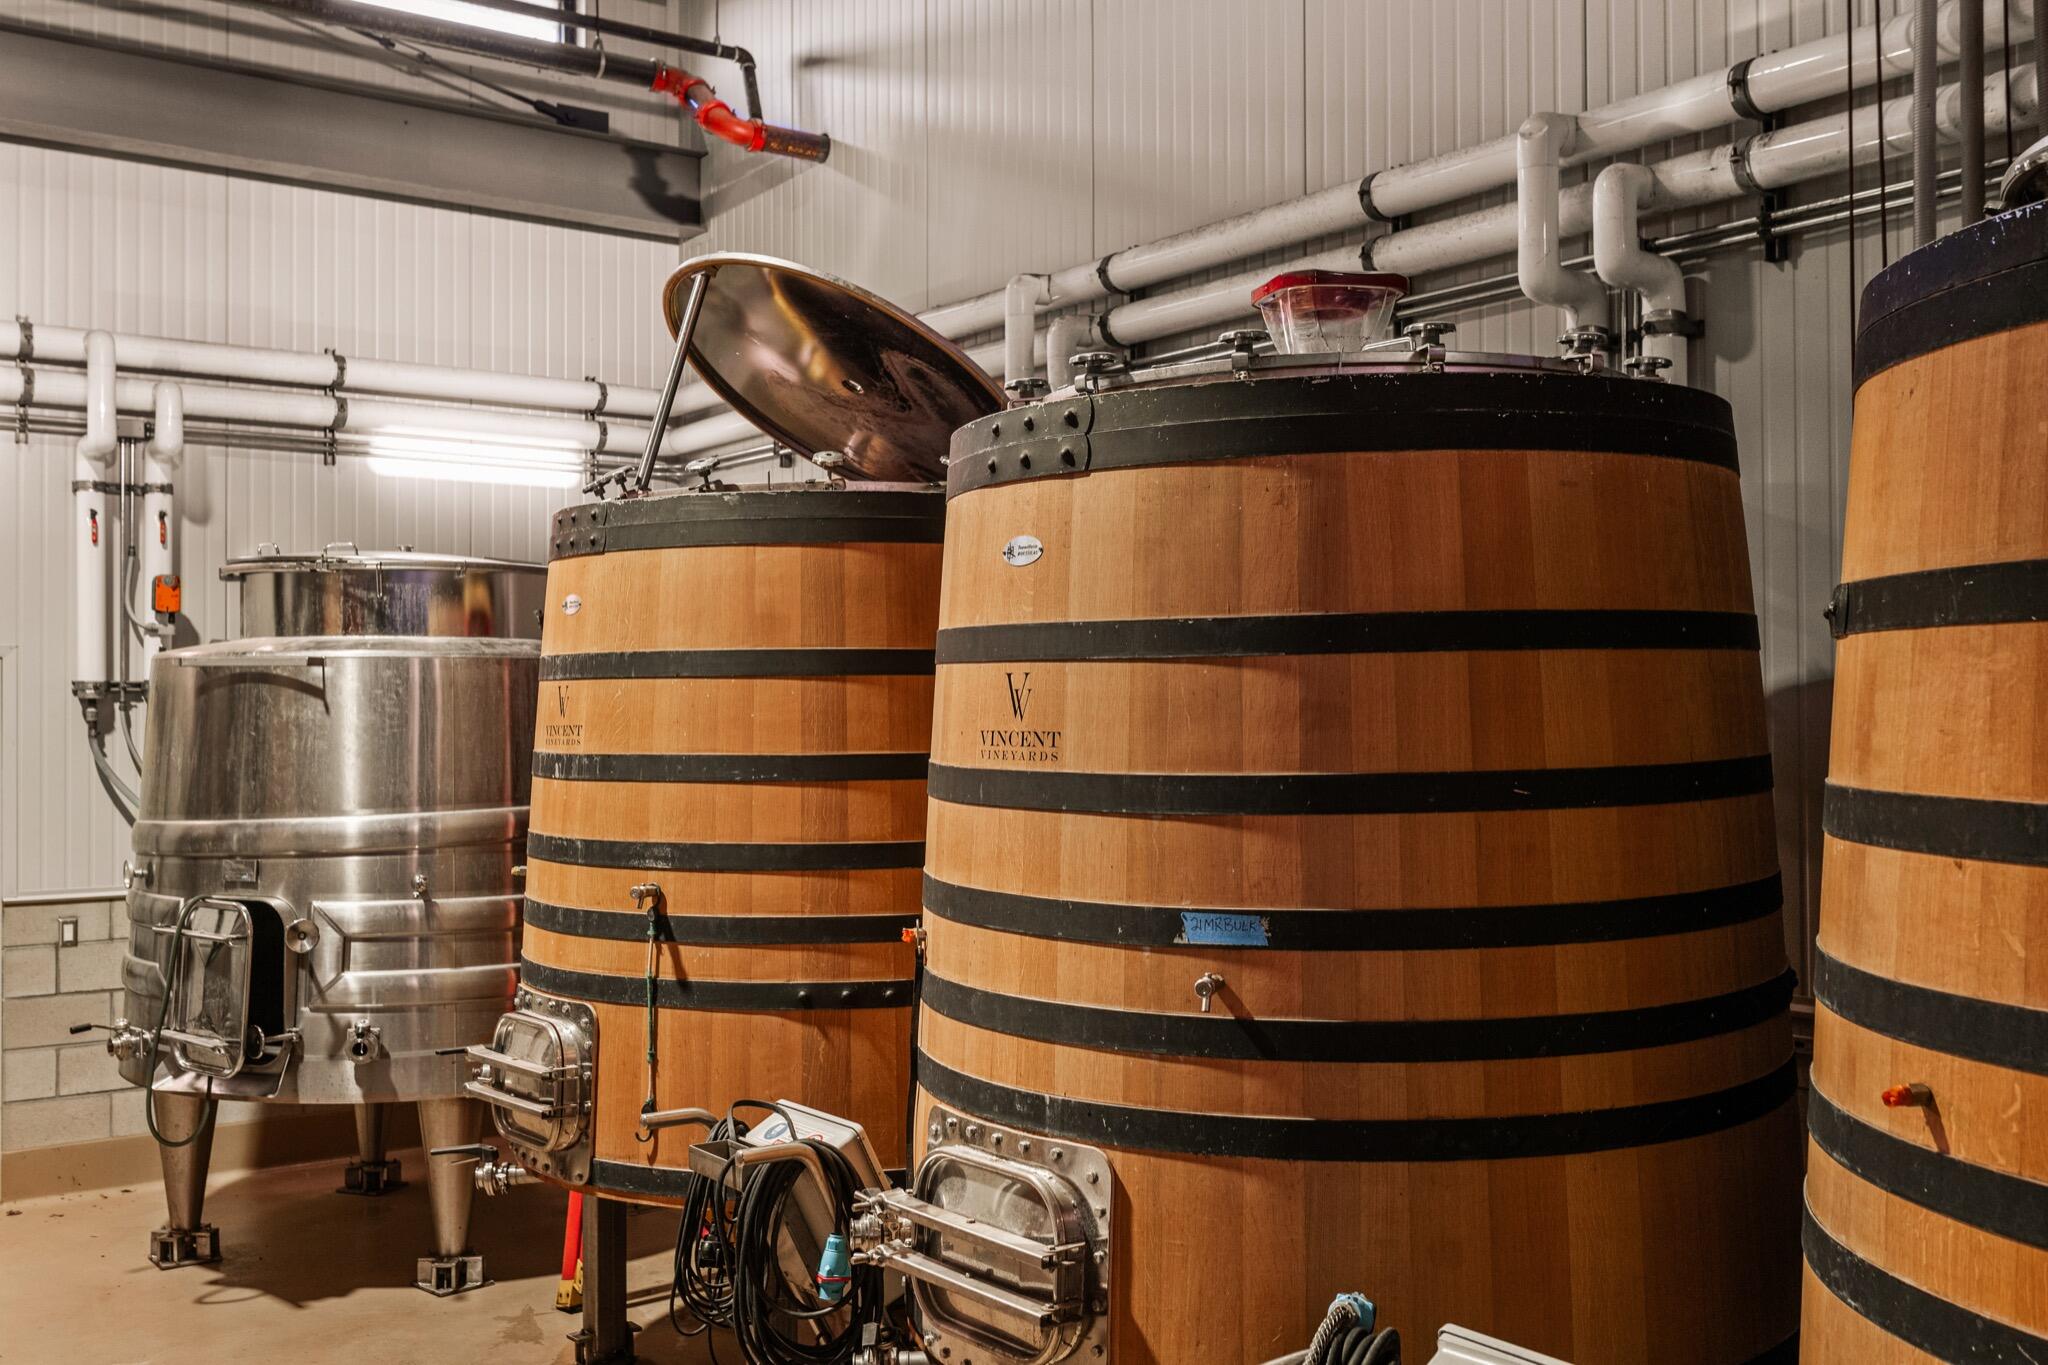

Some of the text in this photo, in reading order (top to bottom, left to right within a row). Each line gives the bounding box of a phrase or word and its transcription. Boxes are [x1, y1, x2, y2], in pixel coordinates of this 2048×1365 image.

[546, 725, 583, 737] VINCENT
[980, 730, 1061, 748] VINCENT
[980, 749, 1059, 761] VINEYARDS
